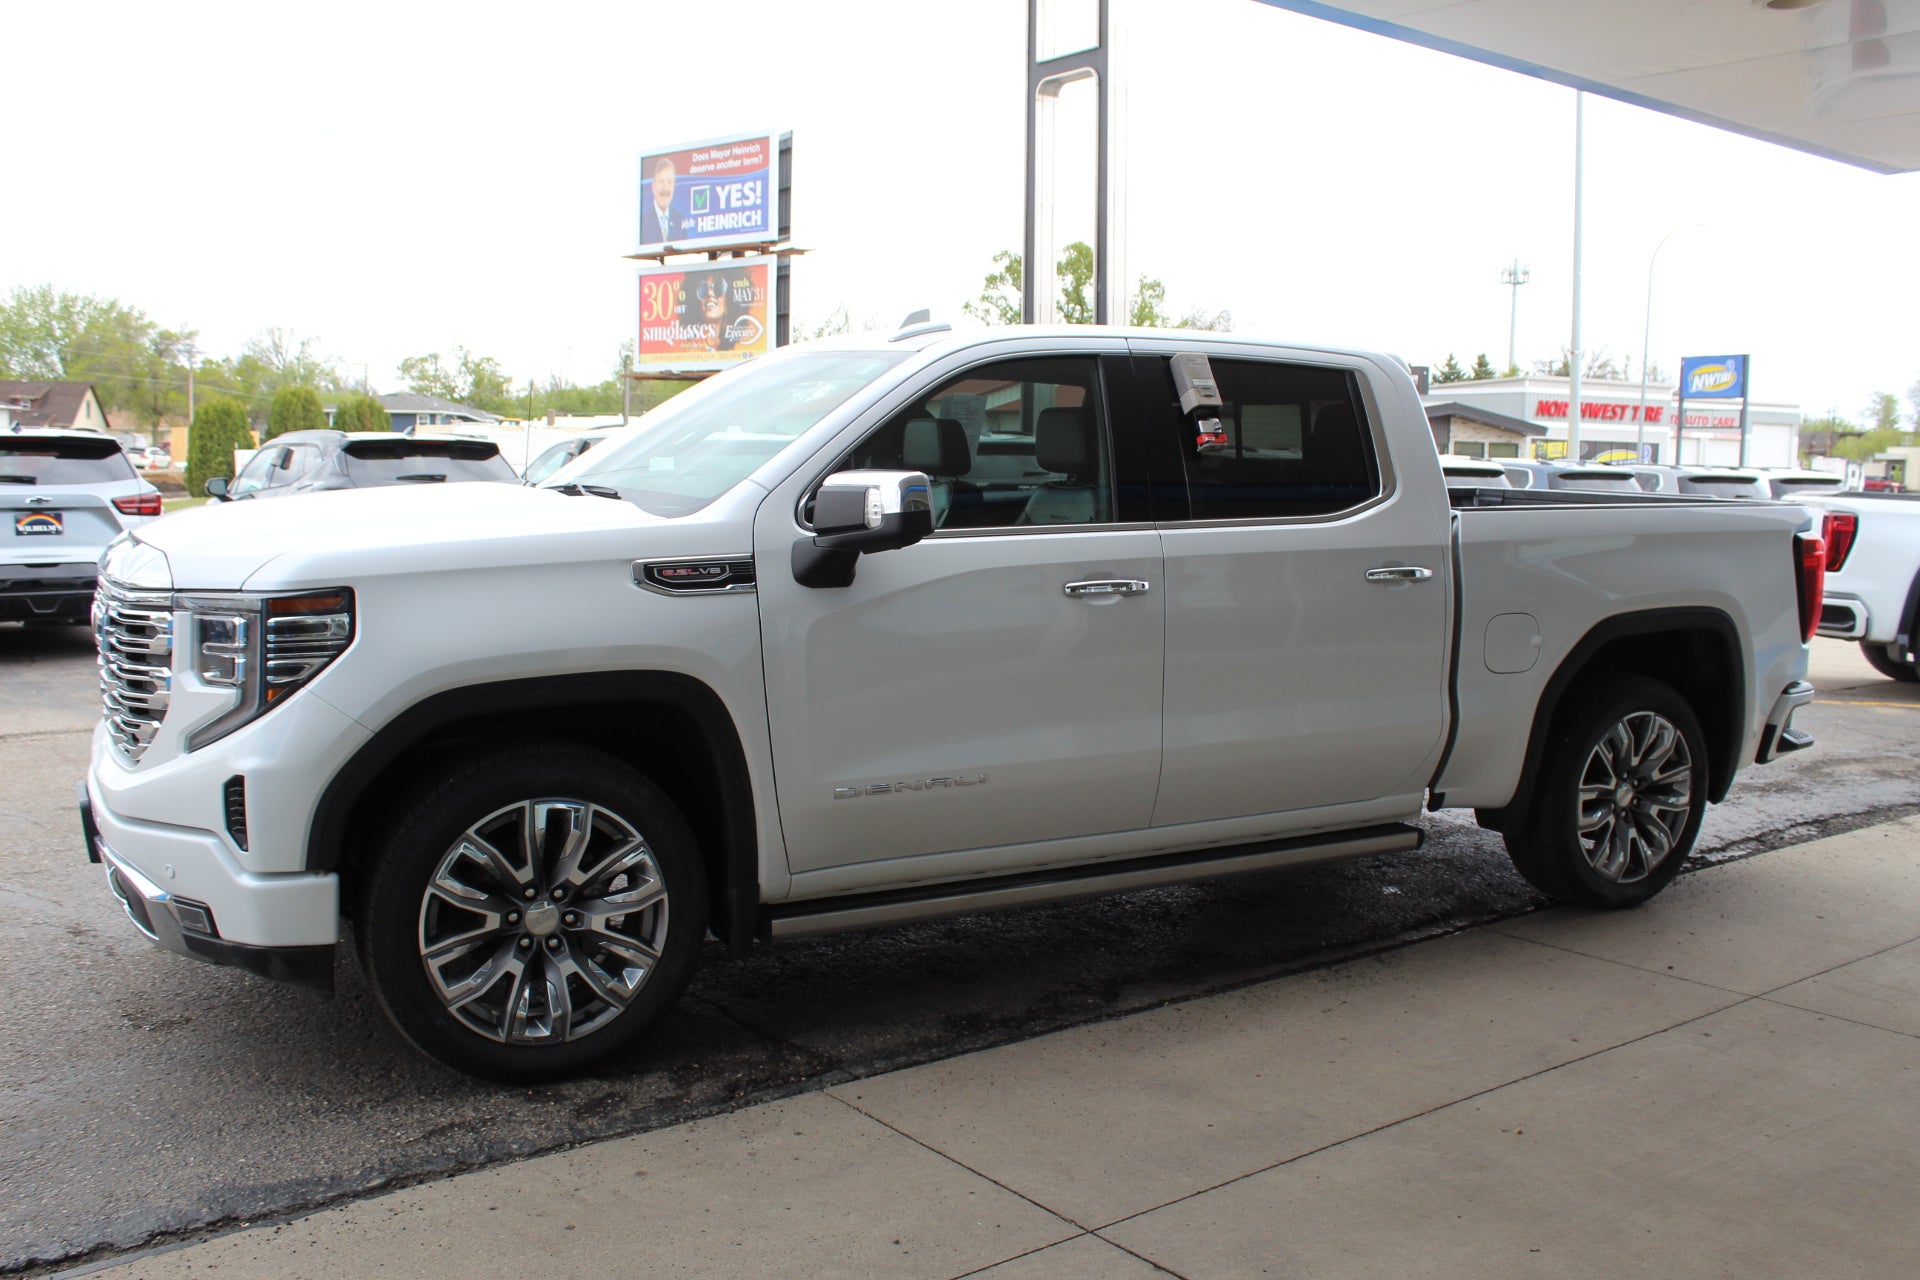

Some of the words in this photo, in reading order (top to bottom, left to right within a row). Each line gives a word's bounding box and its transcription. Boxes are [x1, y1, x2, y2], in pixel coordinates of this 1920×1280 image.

[692, 152, 709, 162] Does
[710, 148, 731, 159] Mayor
[732, 143, 761, 155] Heinrich
[689, 163, 715, 174] deserve
[716, 158, 741, 170] another
[743, 153, 763, 165] term?
[715, 180, 762, 209] YES!
[697, 209, 762, 232] HEINRICH
[733, 288, 754, 303] MAY
[754, 287, 764, 301] 31
[643, 319, 716, 346] sunglasses
[1631, 405, 1664, 422] TRE
[1713, 416, 1737, 428] CARE
[834, 773, 988, 799] DENALI
